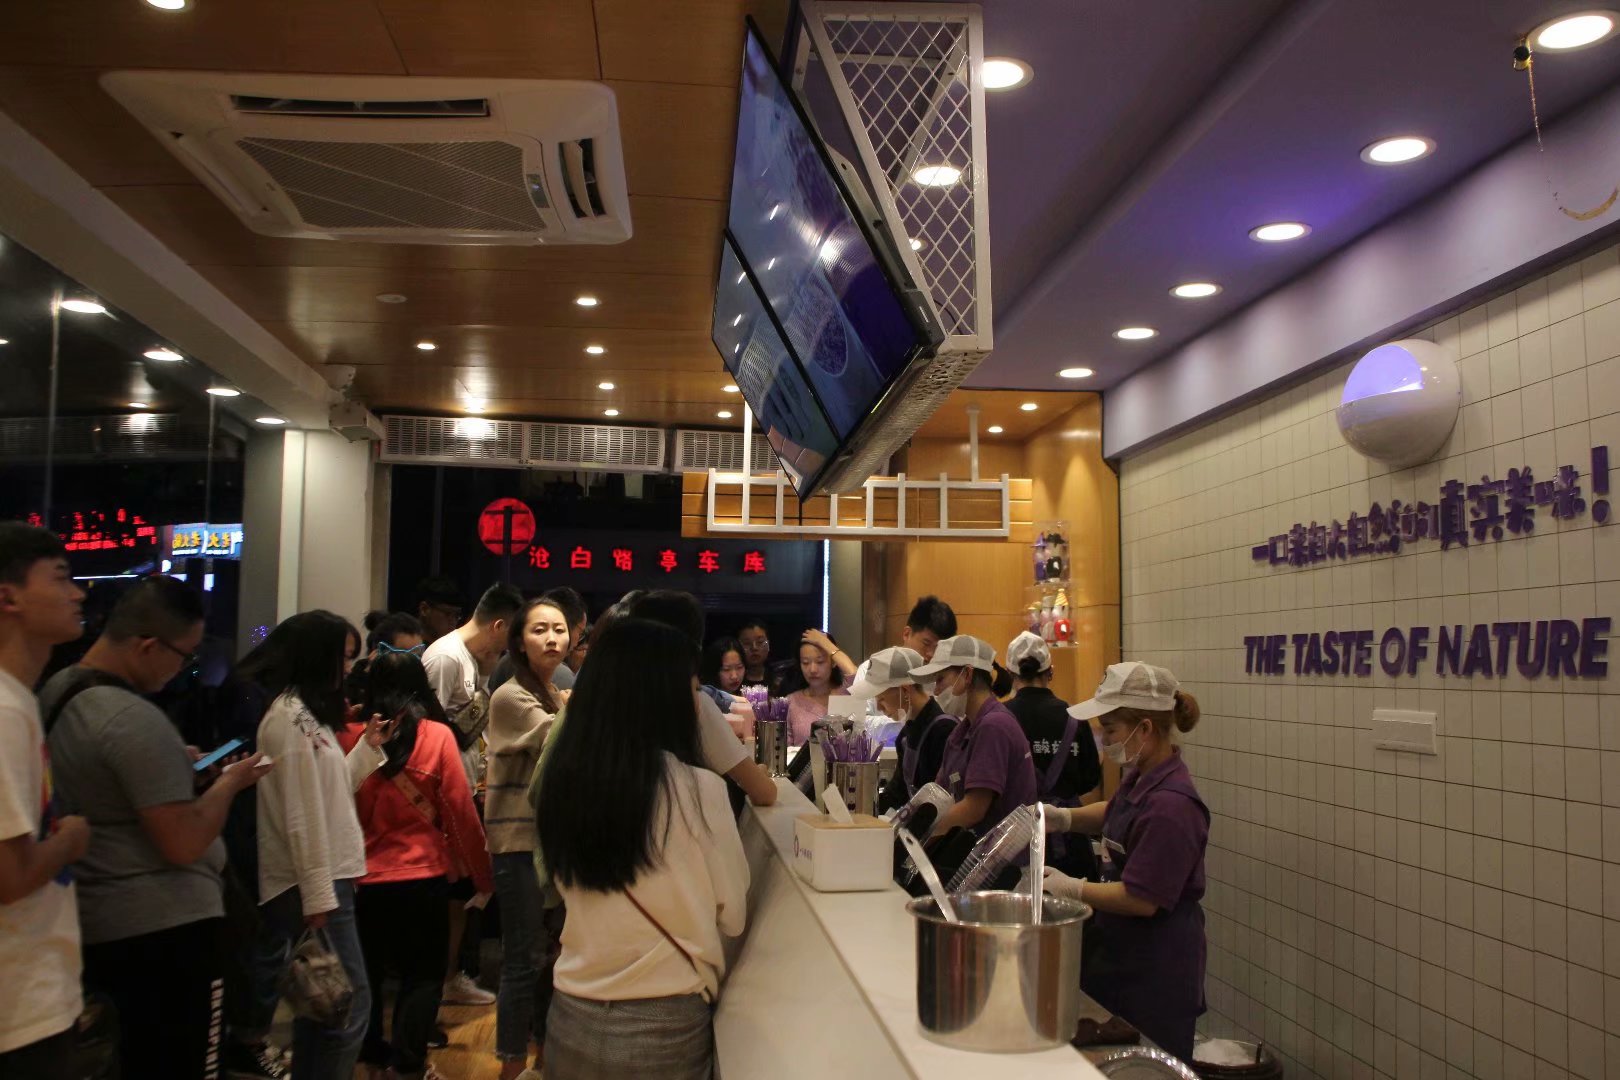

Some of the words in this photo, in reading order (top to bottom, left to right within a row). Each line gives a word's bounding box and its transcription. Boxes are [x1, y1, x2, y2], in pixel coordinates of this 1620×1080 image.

[1244, 634, 1287, 675] THE
[1291, 630, 1374, 677] TASTE
[1379, 627, 1429, 677] OF
[1436, 617, 1611, 679] NATURE
